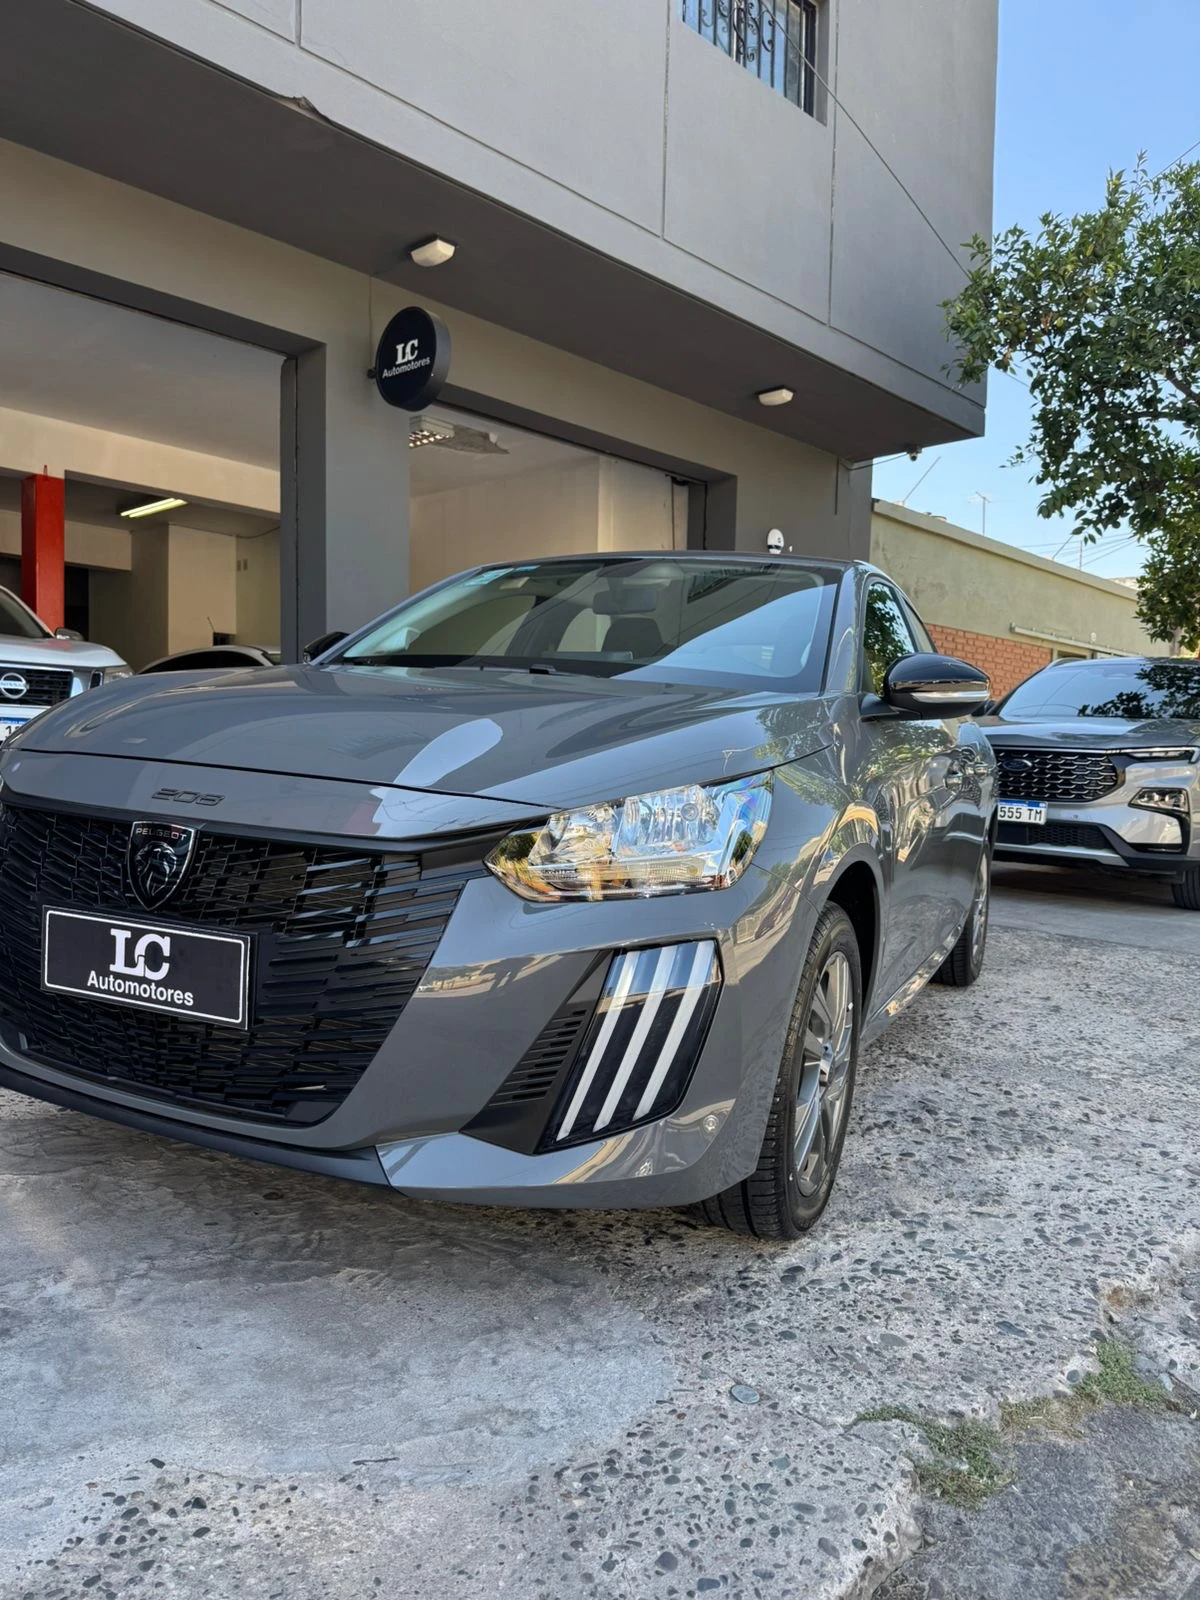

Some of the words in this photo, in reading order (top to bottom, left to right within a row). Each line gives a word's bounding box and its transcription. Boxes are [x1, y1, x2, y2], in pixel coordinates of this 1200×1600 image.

[395, 338, 419, 365] LC
[381, 356, 431, 379] Automotores
[151, 788, 225, 806] 208
[999, 806, 1022, 820] 555
[1027, 808, 1042, 821] TM
[109, 927, 171, 981] LC
[86, 970, 195, 1007] Automotores
